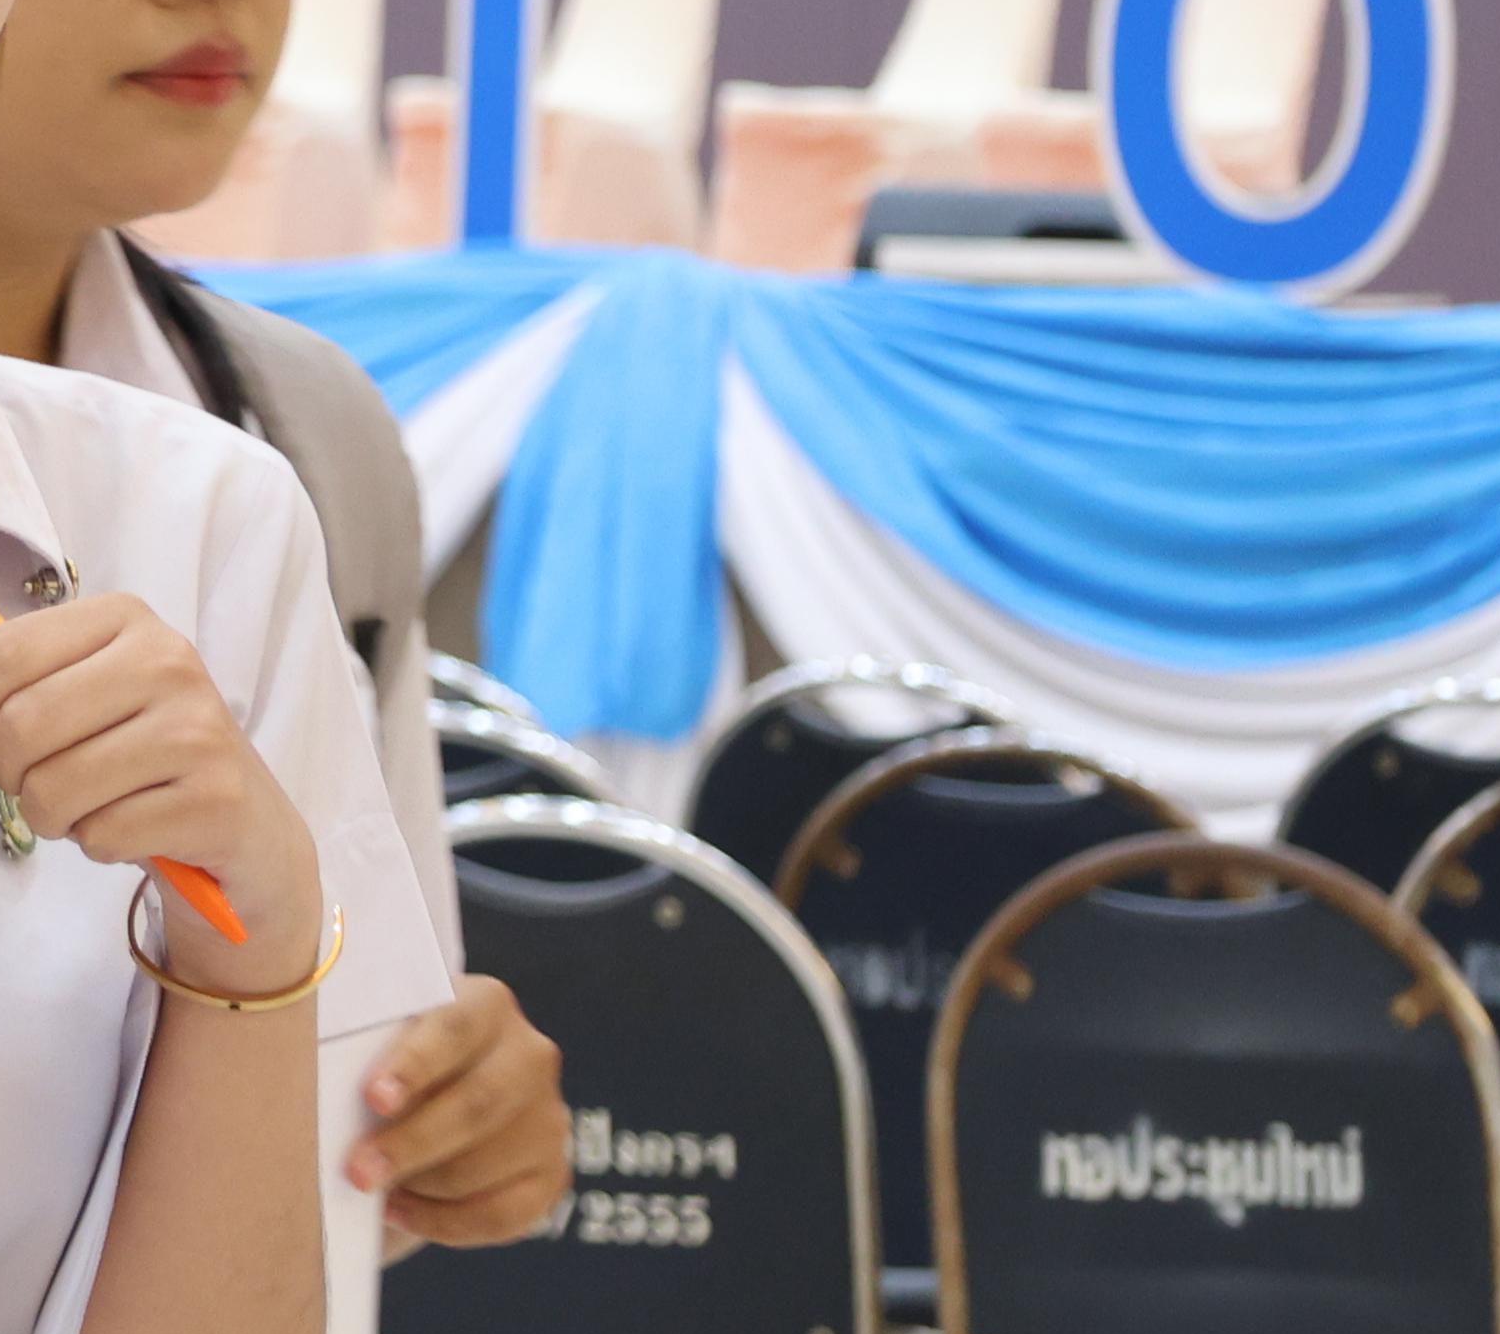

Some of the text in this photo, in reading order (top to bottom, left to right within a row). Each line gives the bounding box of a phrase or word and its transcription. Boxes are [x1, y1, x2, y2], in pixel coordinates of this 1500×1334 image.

[1042, 1115, 1364, 1229] หอประชุมใหม่
